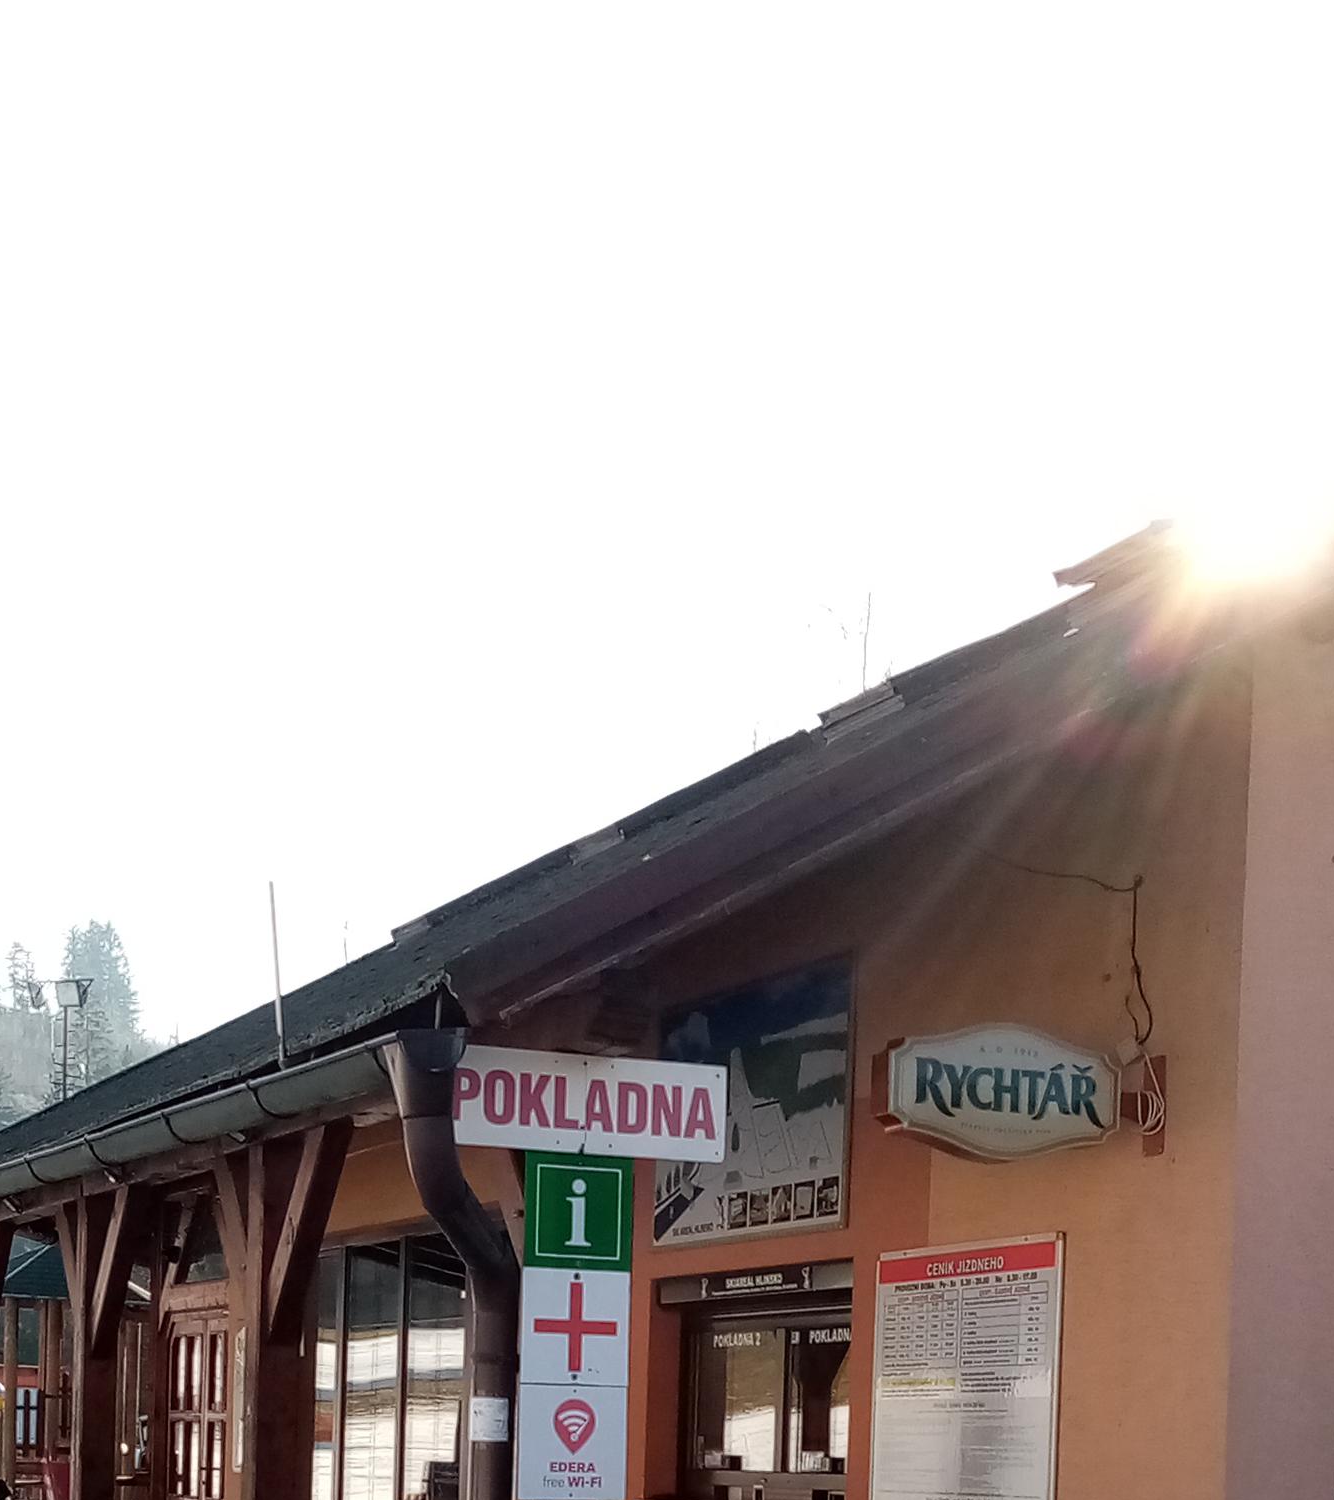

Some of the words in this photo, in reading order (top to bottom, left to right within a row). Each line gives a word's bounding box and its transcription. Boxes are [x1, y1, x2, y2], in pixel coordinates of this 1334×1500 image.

[914, 1056, 1105, 1129] RYCHTÁŘ
[452, 1067, 716, 1140] POKLADNA
[713, 1332, 754, 1348] POKLADNA
[755, 1332, 762, 1347] 2
[809, 1327, 852, 1344] POKLADN
[549, 1461, 596, 1473] EDERA
[543, 1476, 565, 1489] free
[567, 1476, 602, 1489] Wi-Fi
